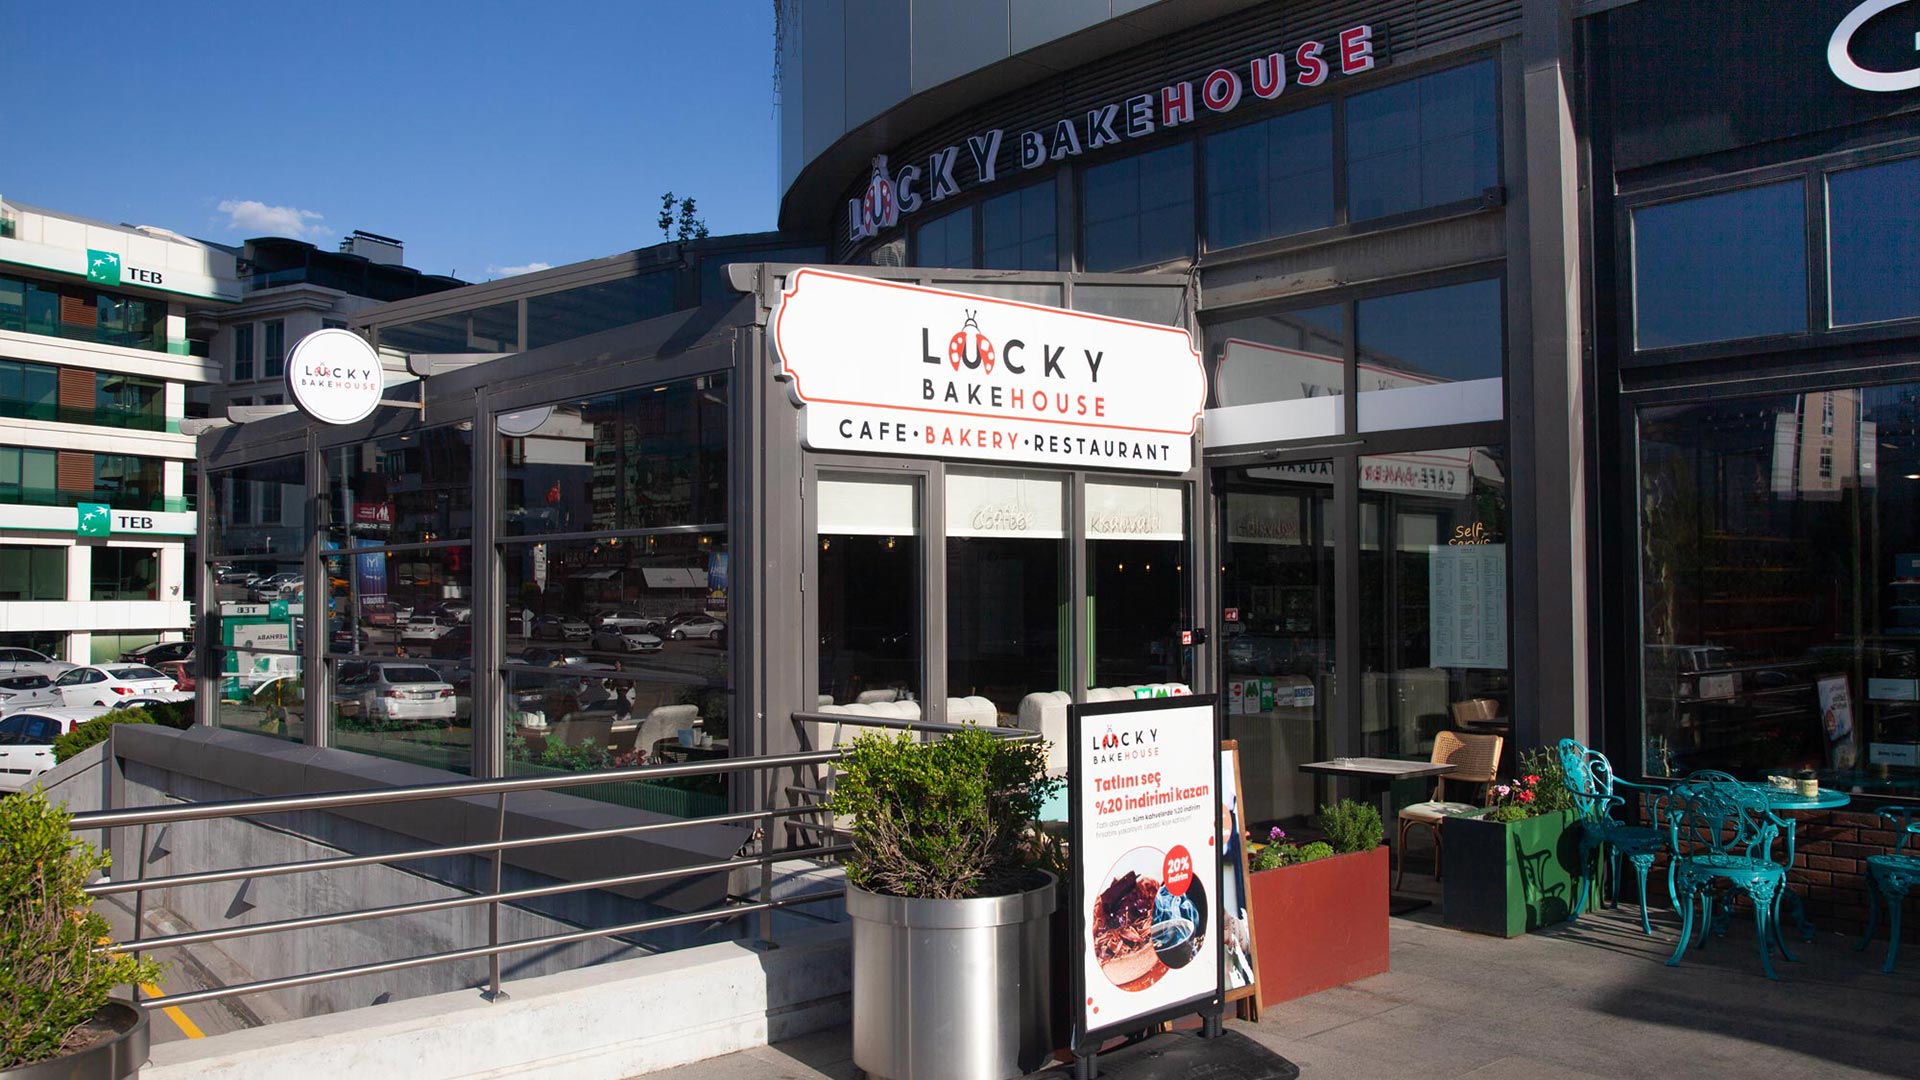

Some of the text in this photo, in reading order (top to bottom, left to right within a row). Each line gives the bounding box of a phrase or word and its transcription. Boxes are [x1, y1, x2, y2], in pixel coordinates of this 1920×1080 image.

[849, 25, 1375, 242] LUCKY BAKEHOUSE
[127, 266, 163, 285] TEB
[921, 327, 1104, 383] LUCKY
[305, 364, 371, 380] LUCKY
[301, 378, 376, 391] BAKEHOUSE
[922, 378, 1106, 417] BAKEHOUSE
[838, 418, 1169, 461] CAFE BAKERY RESTAURANT
[118, 515, 154, 529] TEB
[1455, 521, 1483, 538] Self
[1093, 728, 1158, 750] LUCKY
[1093, 747, 1159, 764] BAKEHOUSE
[1094, 771, 1162, 792] Tatlını seç
[1095, 784, 1209, 815] %20 indirimi kazan
[1168, 856, 1190, 874] 20%
